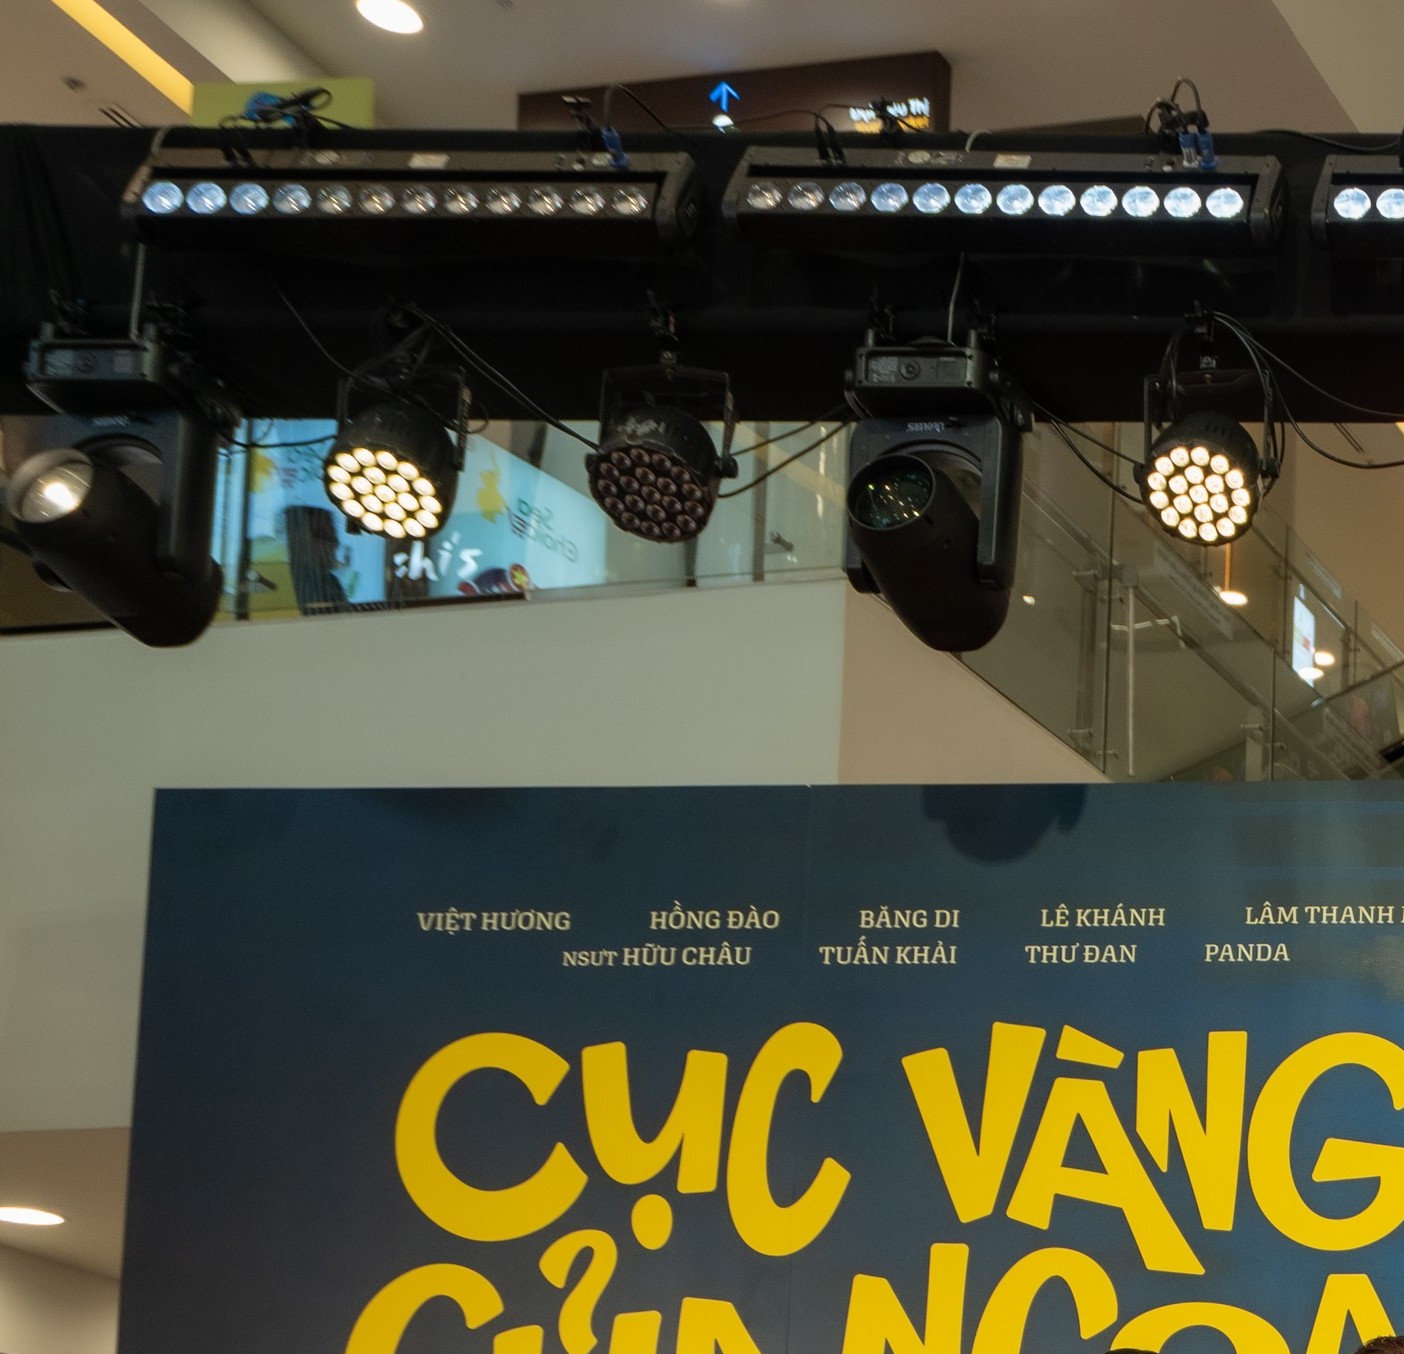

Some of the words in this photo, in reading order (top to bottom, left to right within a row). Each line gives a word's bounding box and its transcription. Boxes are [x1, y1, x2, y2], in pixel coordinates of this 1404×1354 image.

[416, 906, 477, 935] VIỆT
[481, 907, 571, 931] HƯƠNG
[649, 900, 720, 930] HỒNG
[727, 901, 780, 929] ĐÀO
[859, 904, 928, 929] BĂNG
[934, 909, 960, 928] DI
[1040, 902, 1070, 928] LÊ
[1075, 901, 1166, 927] KHÁNH
[1244, 900, 1299, 925] LÂM
[1304, 905, 1396, 925] THANH
[562, 948, 618, 967] NSƯT
[622, 943, 677, 966] HỮU
[681, 941, 752, 966] CHÂU
[819, 935, 889, 965] TUẤN
[895, 937, 957, 965] KHẢI
[1025, 942, 1079, 964] THƯ
[1083, 944, 1137, 963] ĐAN
[1204, 943, 1291, 963] PANDA
[395, 1021, 852, 1256] CỤC
